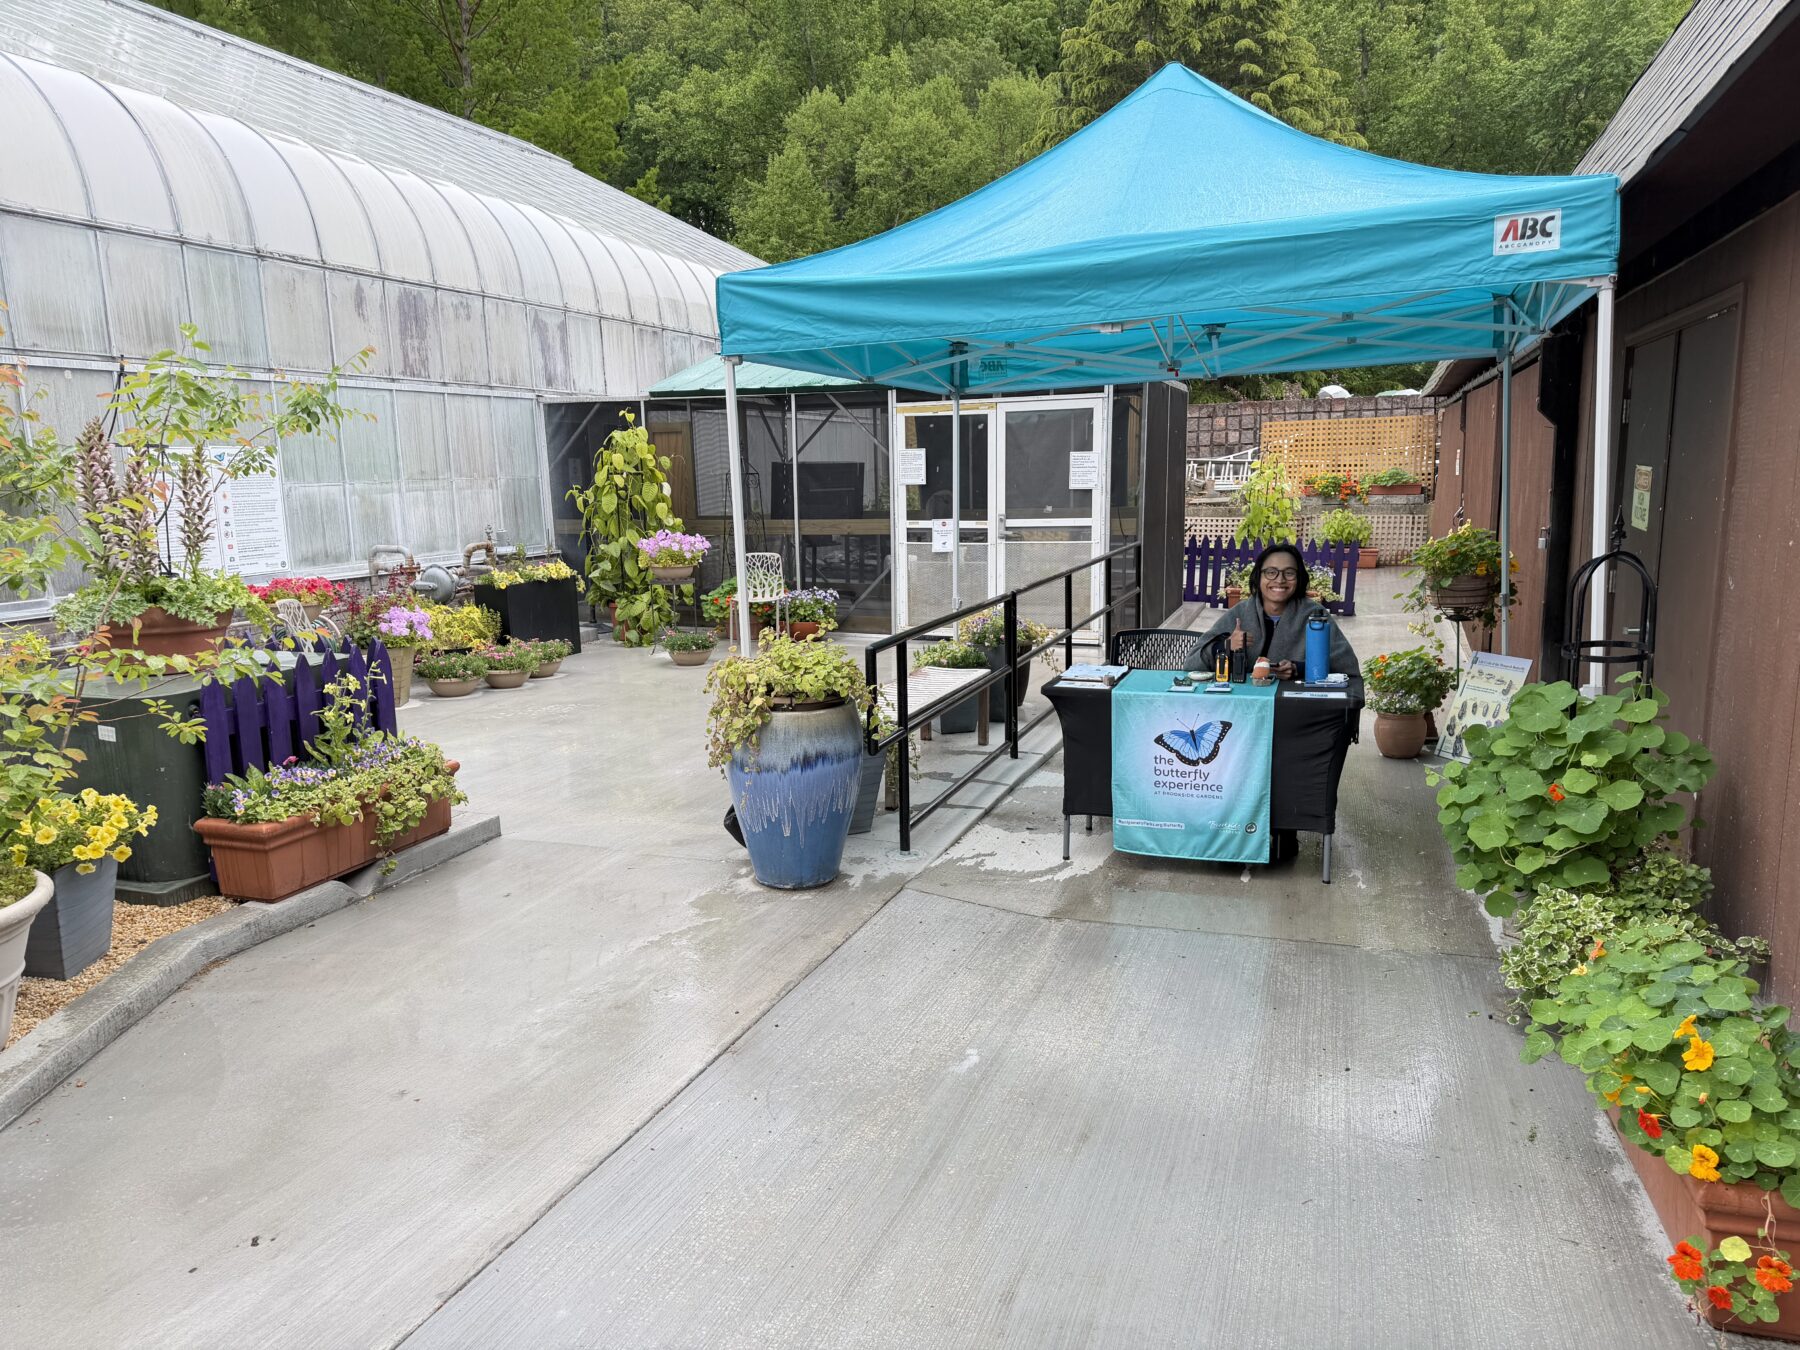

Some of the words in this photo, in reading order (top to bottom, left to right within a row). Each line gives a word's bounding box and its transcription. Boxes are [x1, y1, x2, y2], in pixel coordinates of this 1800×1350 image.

[1500, 215, 1555, 242] ABC
[1154, 755, 1174, 766] the
[1154, 766, 1210, 782] butterfly
[1154, 780, 1223, 793] experience
